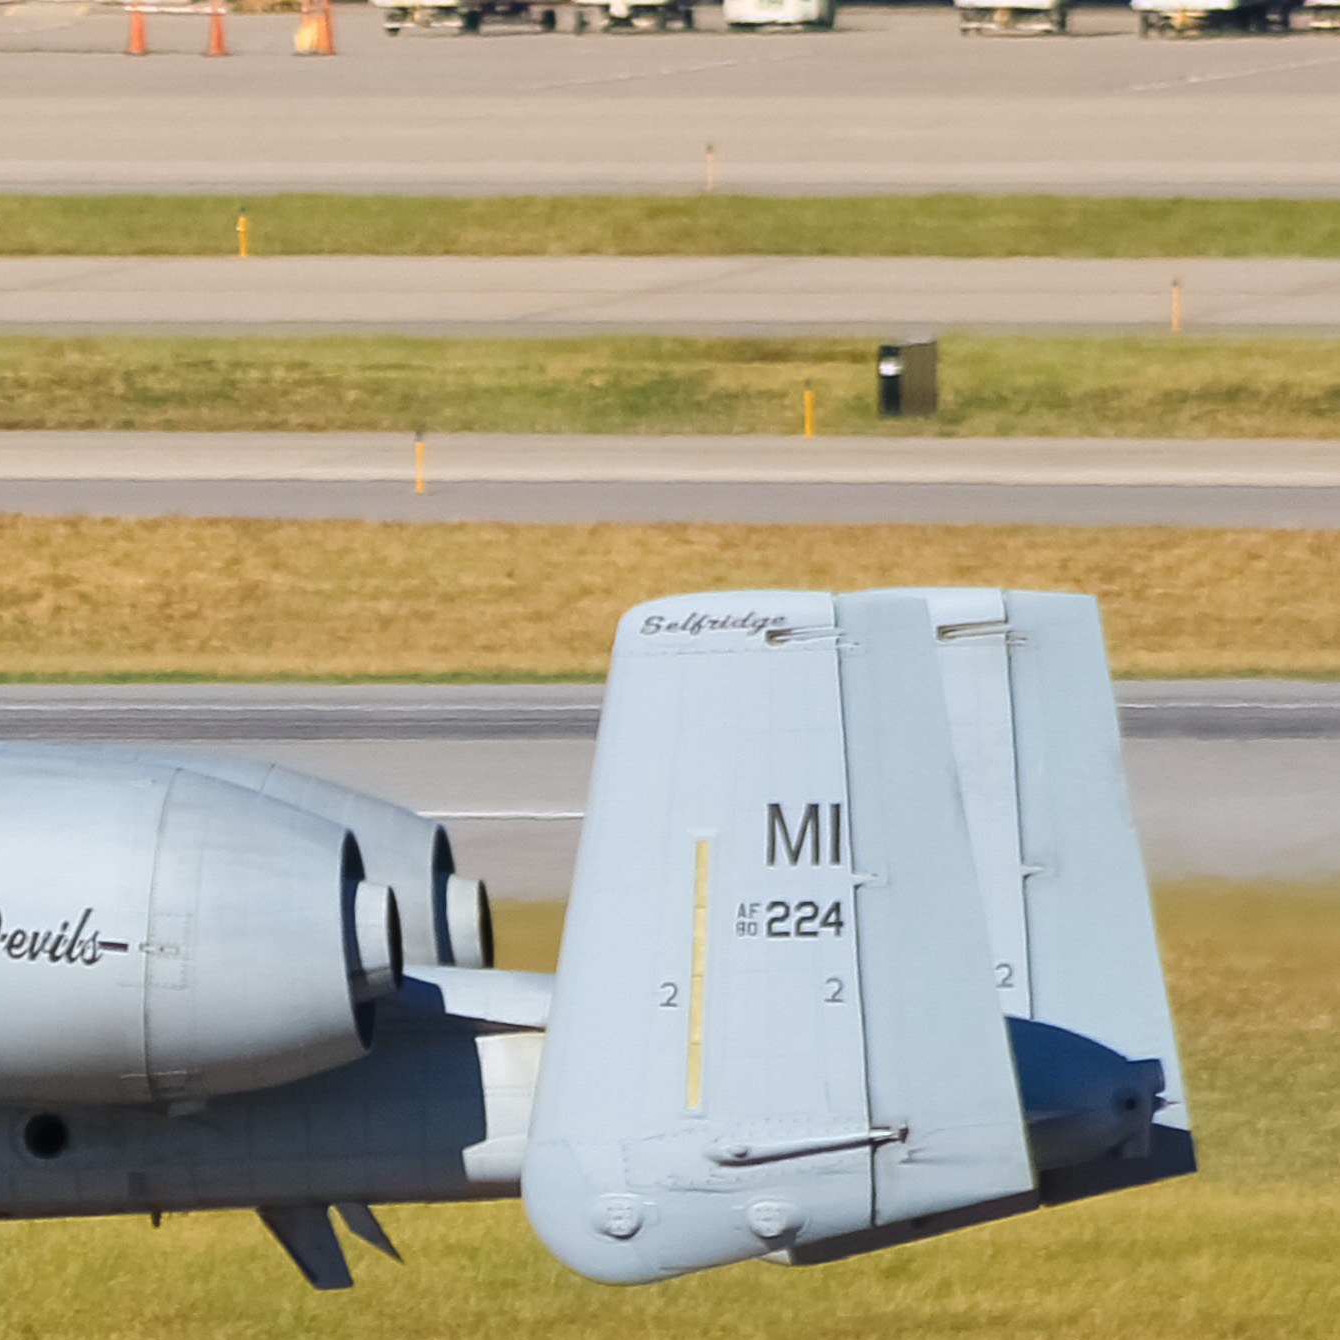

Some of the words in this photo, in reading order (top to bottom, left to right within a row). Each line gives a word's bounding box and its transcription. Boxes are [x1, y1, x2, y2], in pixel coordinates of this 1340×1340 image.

[640, 610, 787, 637] Selfridge
[767, 803, 841, 867] MI
[737, 903, 761, 919] AF
[766, 901, 844, 938] 224
[993, 963, 1015, 989] 2
[659, 982, 680, 1008] 2
[823, 978, 845, 1003] 2
